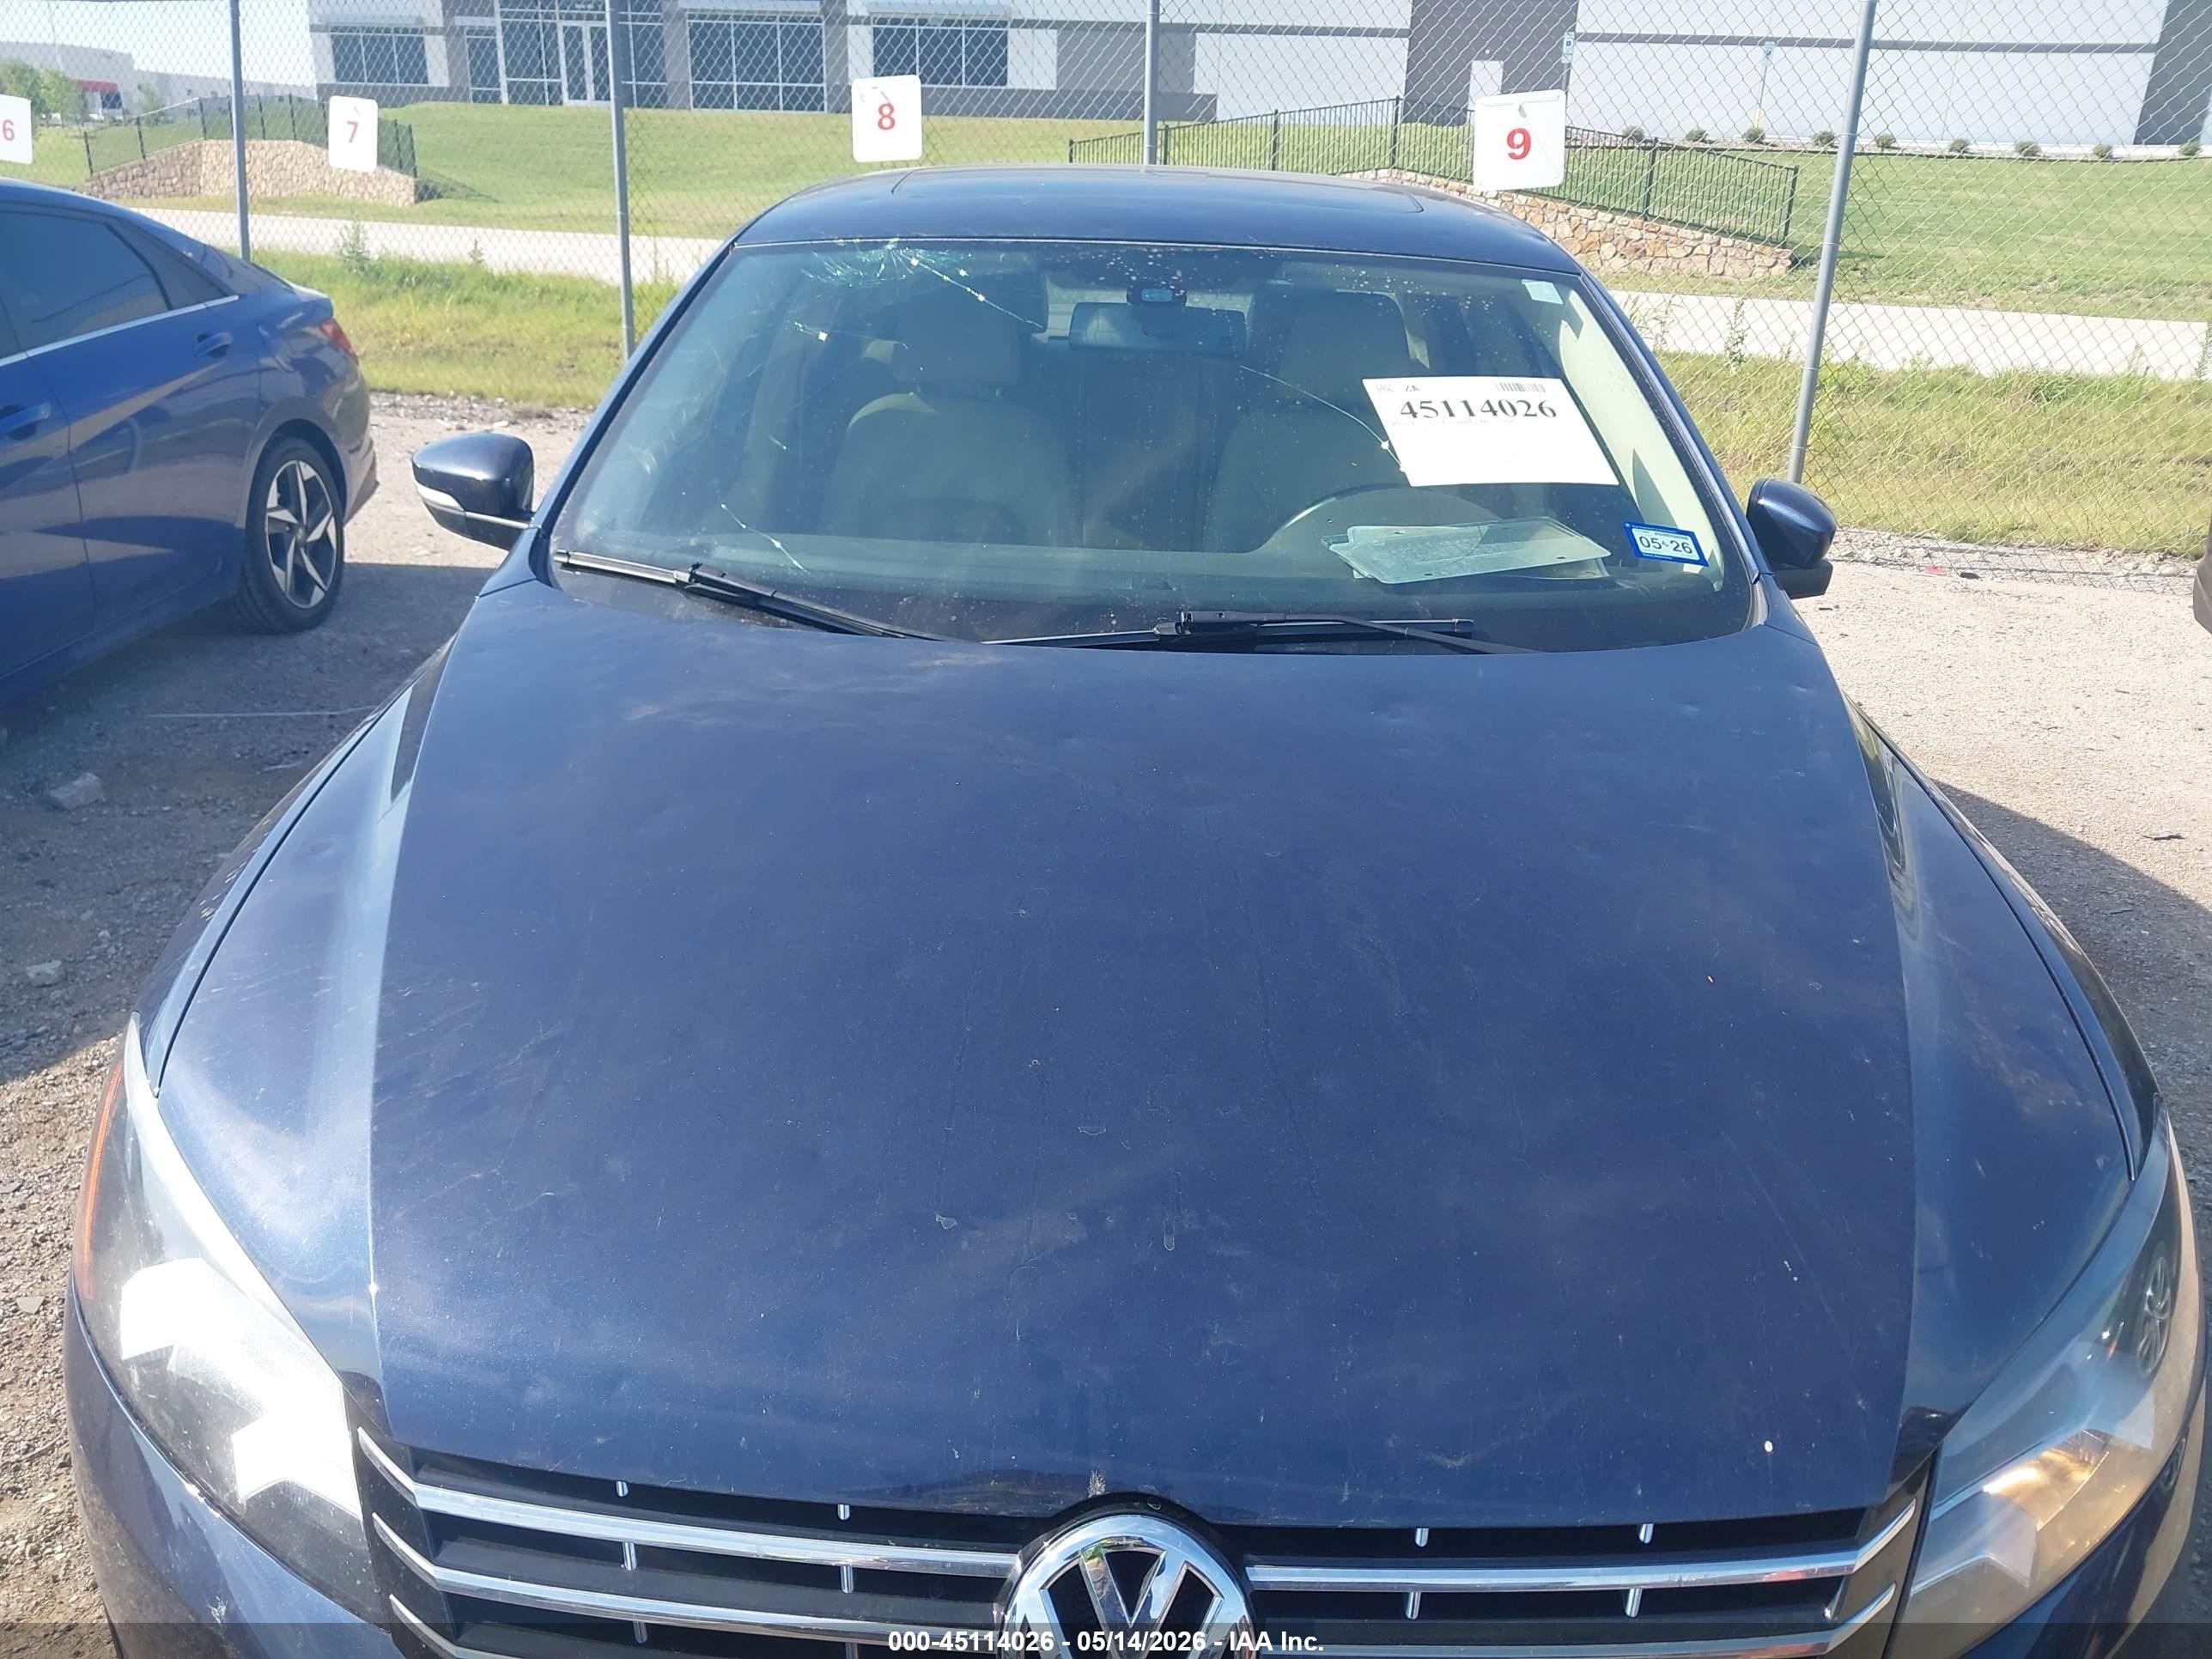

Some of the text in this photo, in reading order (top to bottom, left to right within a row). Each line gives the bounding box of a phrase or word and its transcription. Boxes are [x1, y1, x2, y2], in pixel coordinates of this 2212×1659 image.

[878, 103, 895, 131] 8
[2, 118, 15, 142] 6
[346, 120, 358, 143] 7
[1506, 128, 1531, 160] 9
[1400, 398, 1557, 418] 45114026
